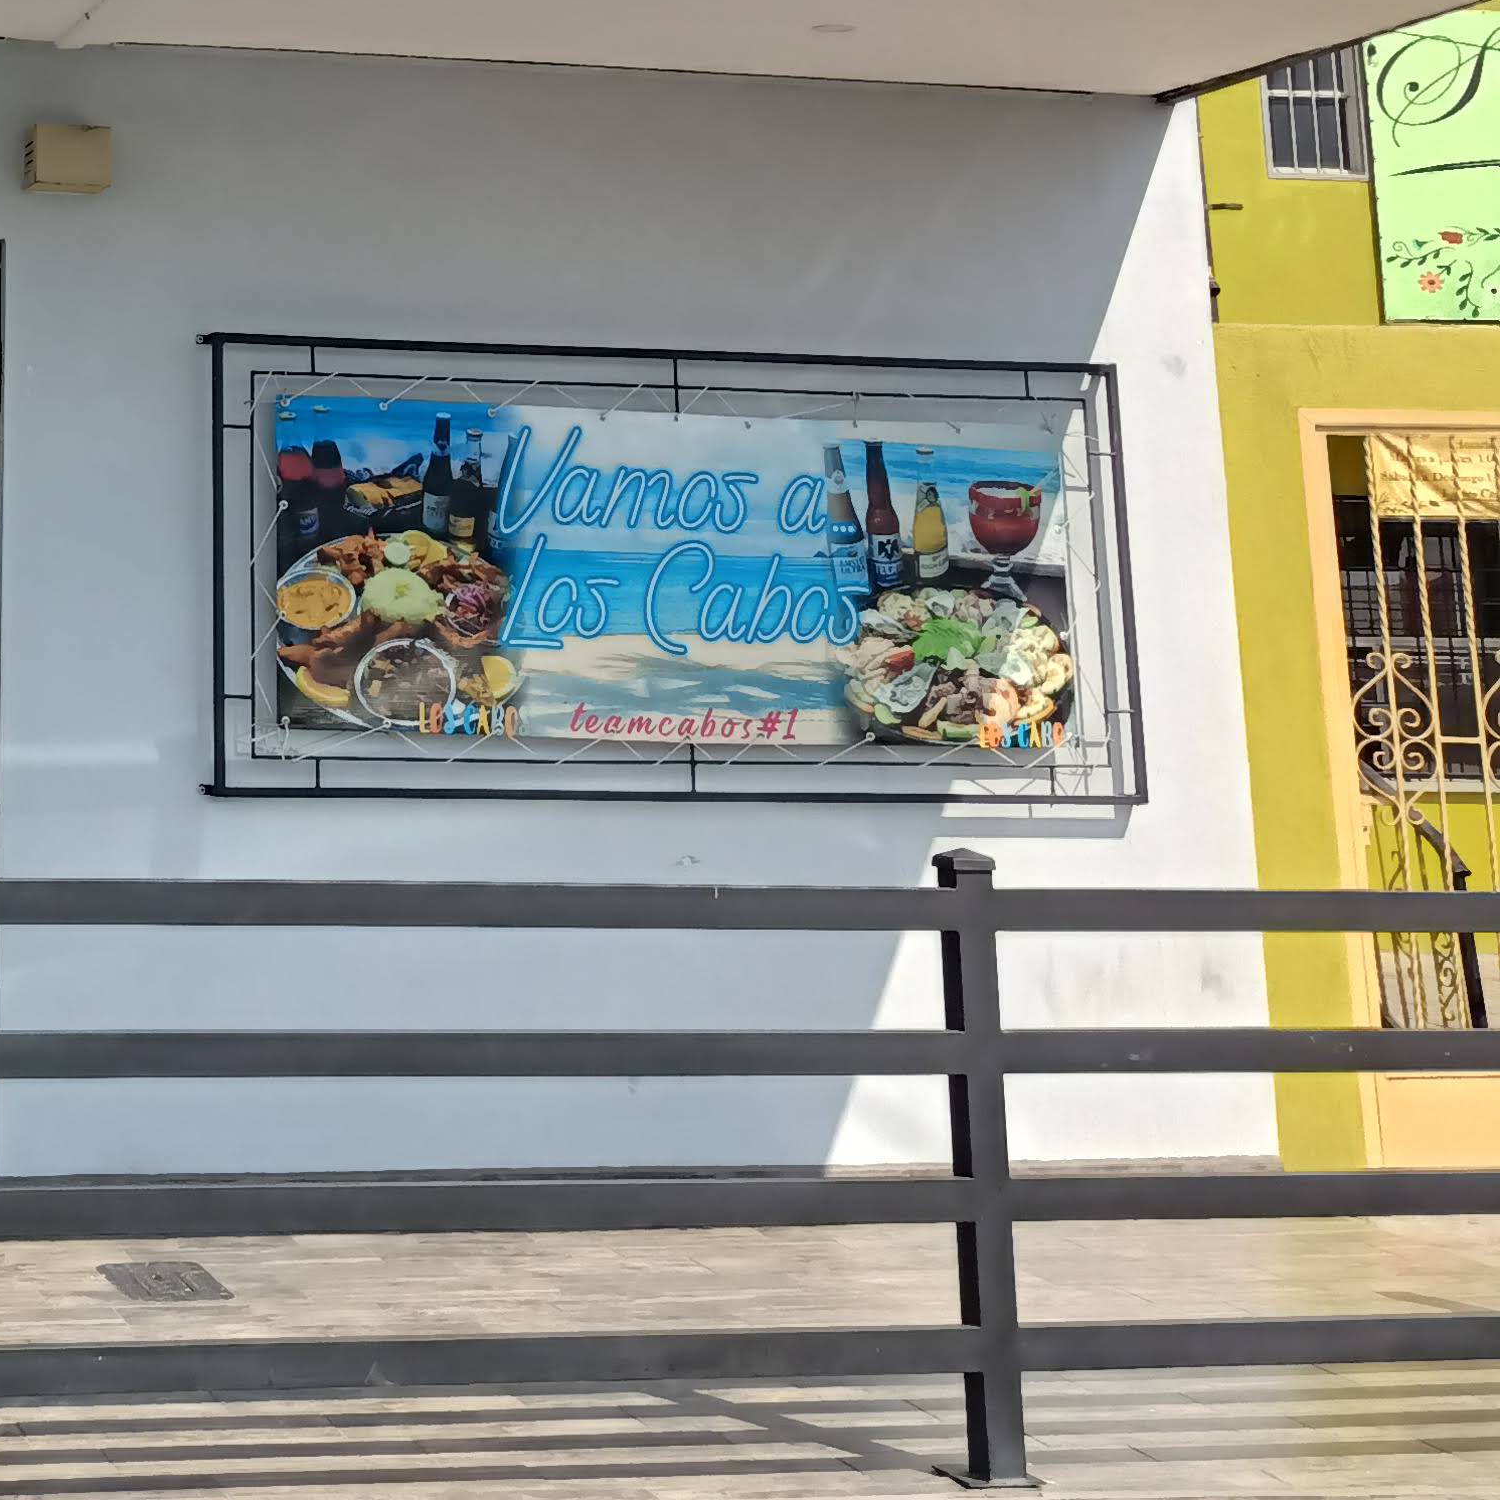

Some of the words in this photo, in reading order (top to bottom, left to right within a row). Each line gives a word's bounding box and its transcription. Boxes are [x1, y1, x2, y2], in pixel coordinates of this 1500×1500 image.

[499, 425, 758, 534] Vamos
[501, 533, 620, 650] Los
[645, 540, 871, 654] Cabos
[419, 701, 455, 735] LOS
[569, 701, 800, 741] teamcabos#1
